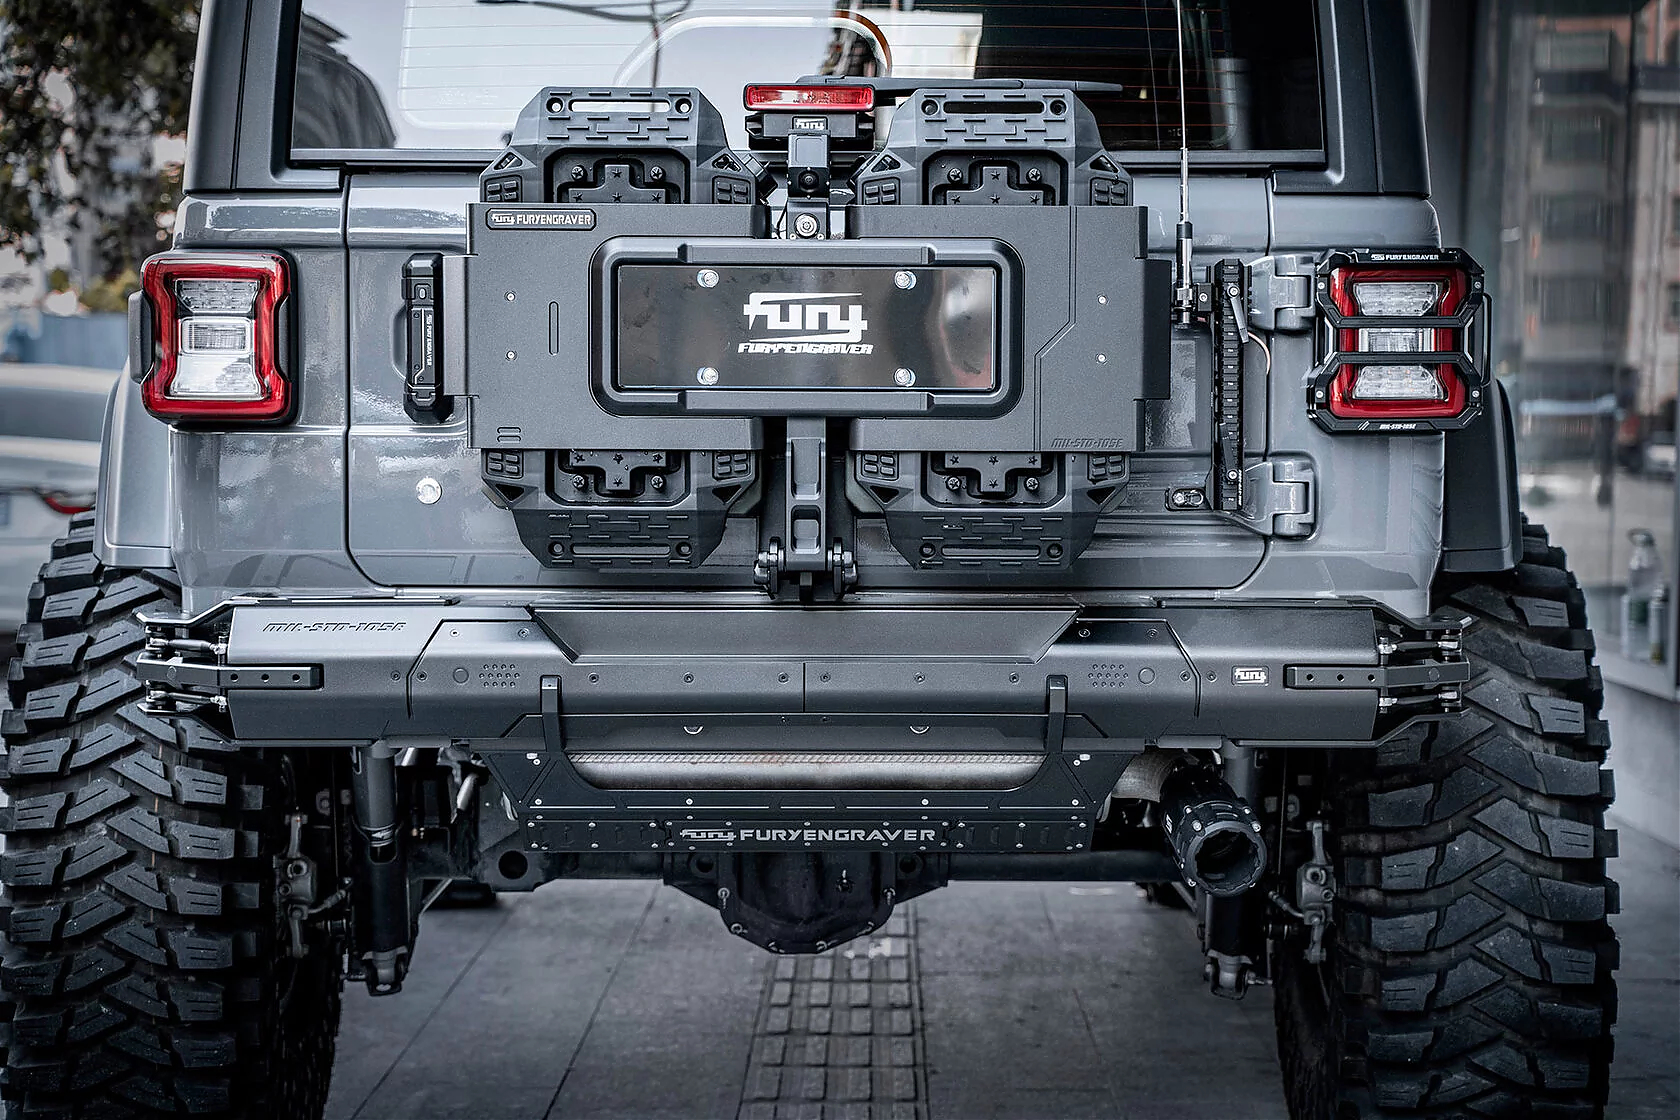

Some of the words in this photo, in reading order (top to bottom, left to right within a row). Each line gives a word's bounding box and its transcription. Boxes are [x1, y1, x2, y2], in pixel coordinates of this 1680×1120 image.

[516, 214, 591, 225] FURYENGRAVER
[743, 292, 868, 343] fury
[740, 829, 936, 841] FURYENGRAVER
